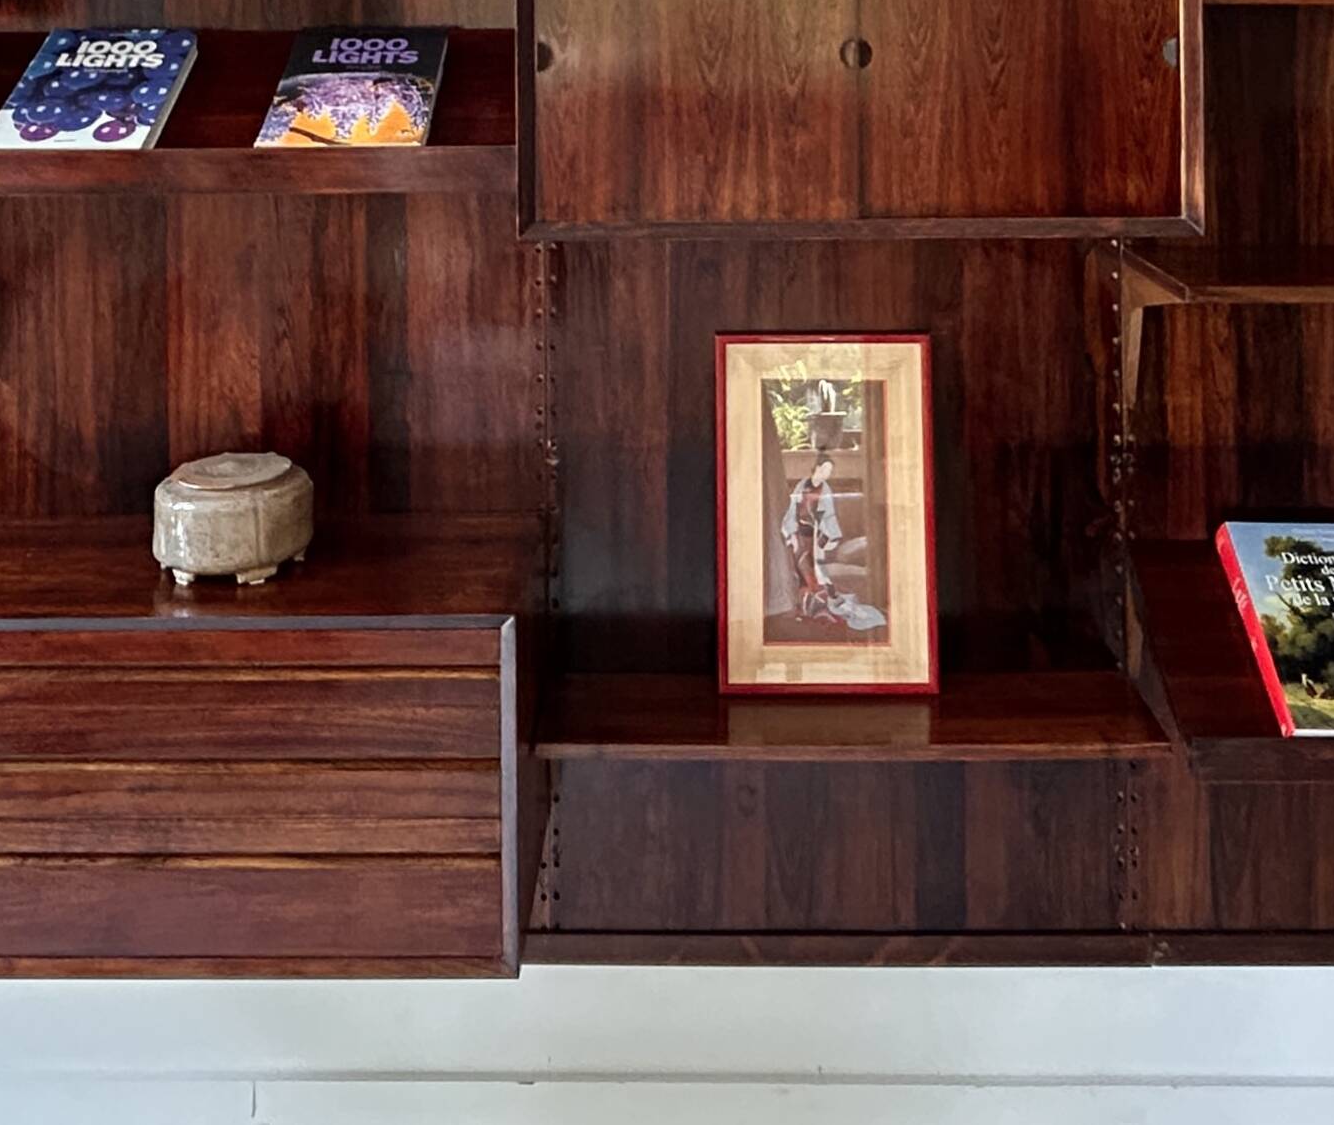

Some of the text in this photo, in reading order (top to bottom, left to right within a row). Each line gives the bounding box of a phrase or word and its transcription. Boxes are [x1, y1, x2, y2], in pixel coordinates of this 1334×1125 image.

[77, 40, 157, 54] 1000
[330, 38, 409, 51] 1000
[56, 53, 165, 68] LIGHTS
[312, 50, 419, 65] LIGHTS
[1265, 574, 1326, 592] Petits
[1292, 593, 1312, 606] de
[1315, 593, 1331, 607] la
